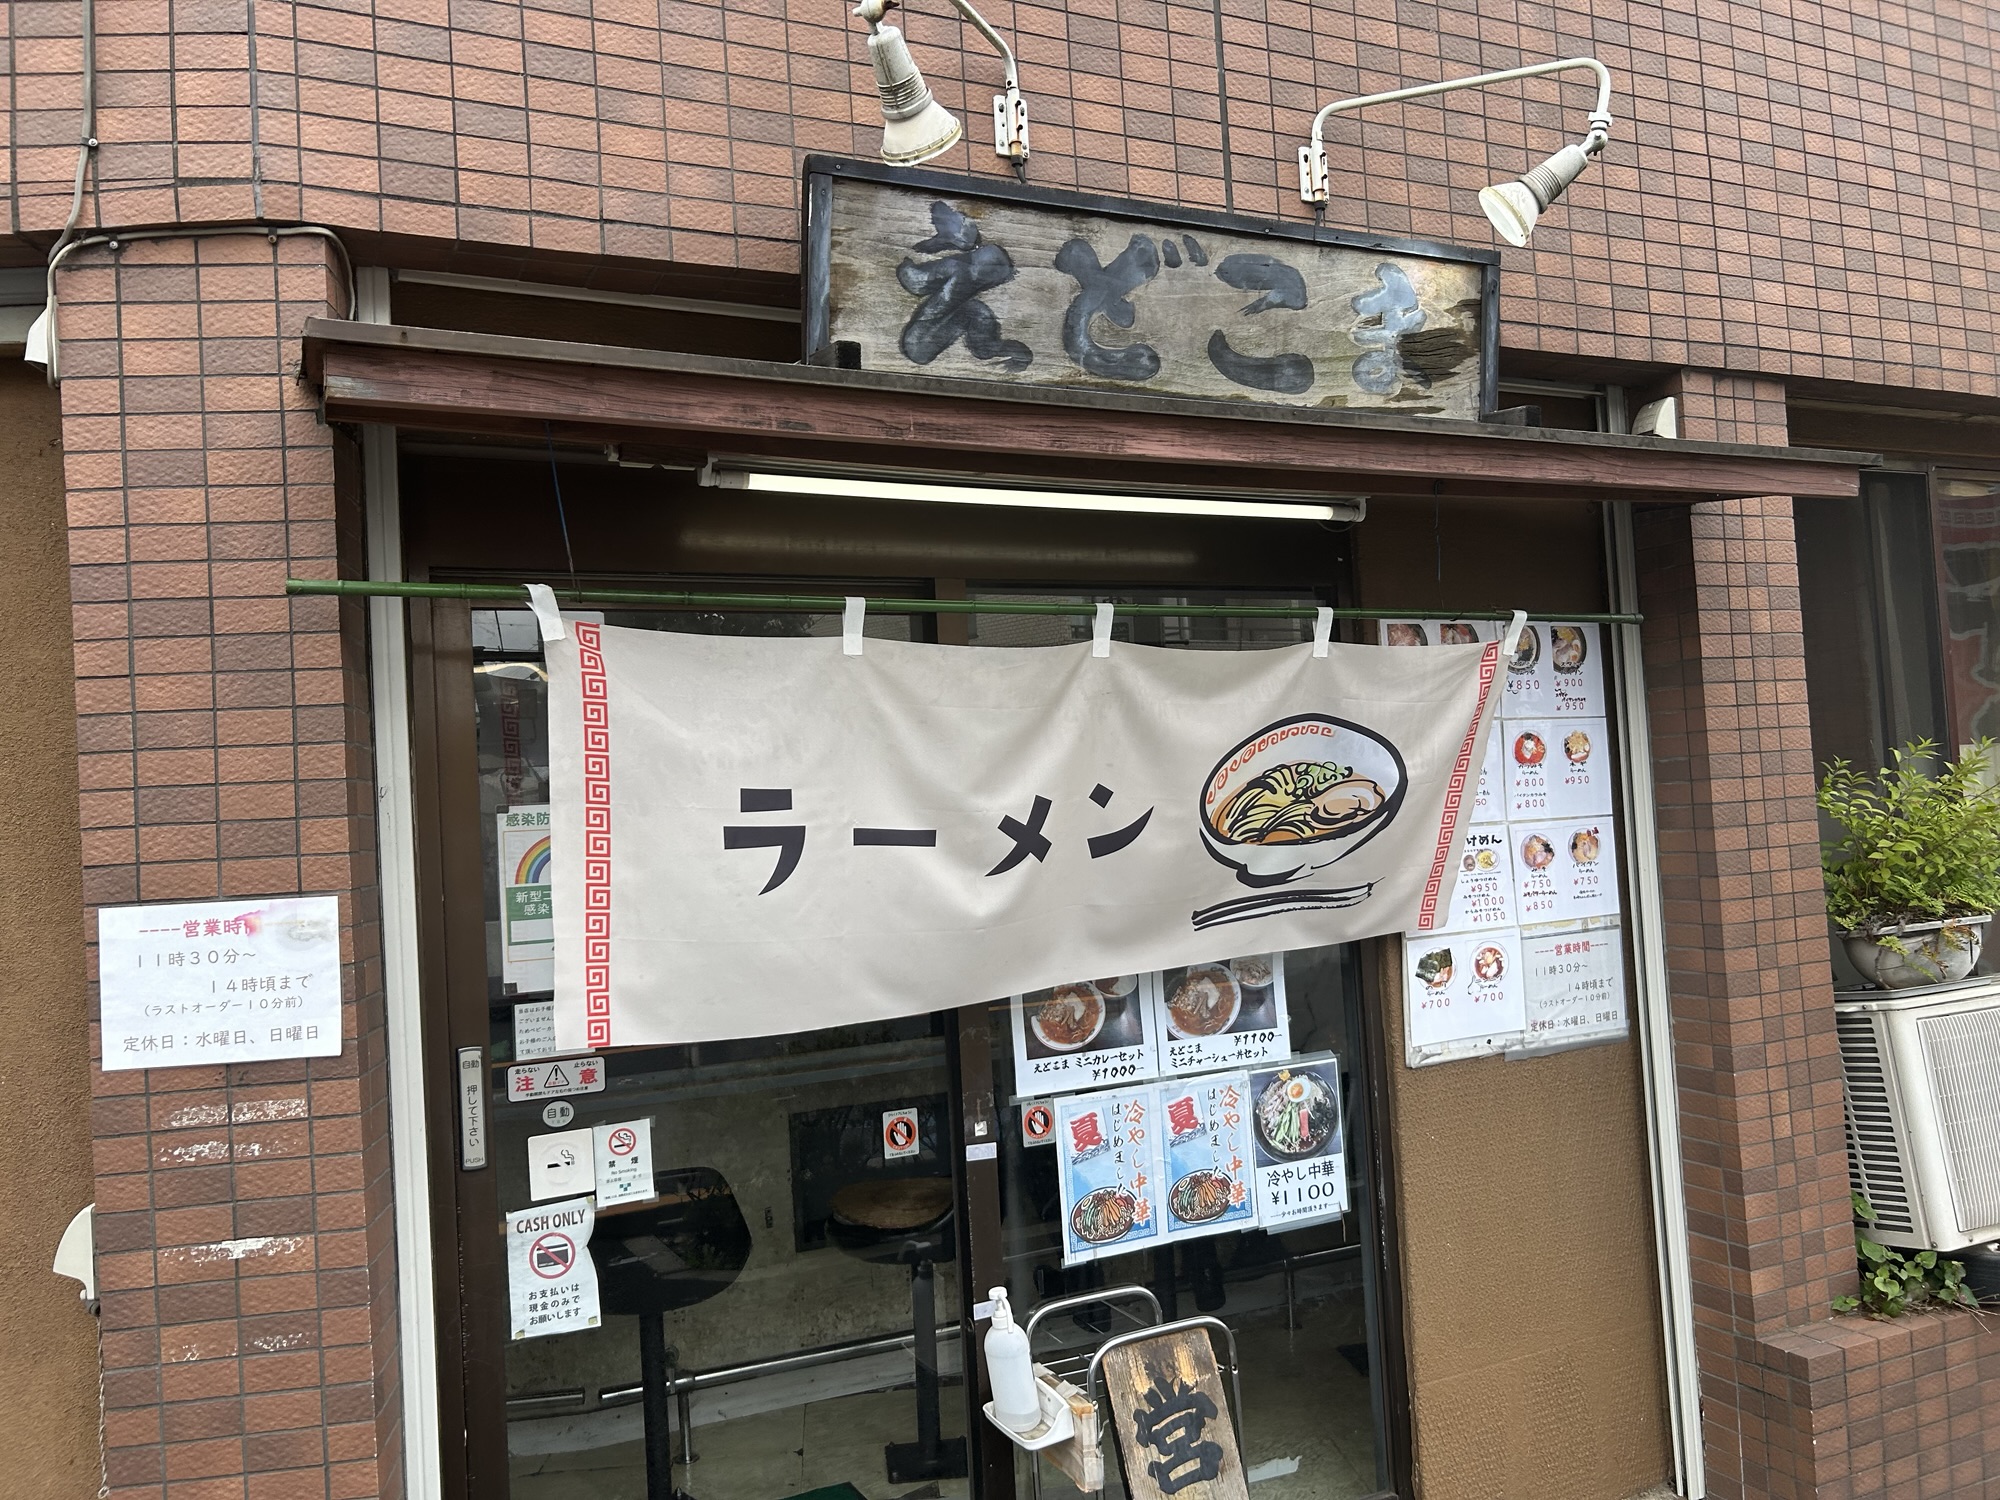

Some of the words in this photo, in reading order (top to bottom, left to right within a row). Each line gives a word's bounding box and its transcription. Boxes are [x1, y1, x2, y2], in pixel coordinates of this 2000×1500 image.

[1507, 680, 1540, 690] ¥850
[1556, 678, 1583, 687] ¥900
[1556, 702, 1584, 711] ¥950
[1515, 778, 1545, 787] ¥800
[1564, 775, 1590, 784] ¥950
[1516, 799, 1545, 809] ¥800
[723, 782, 1155, 896] ラーメン
[1471, 882, 1498, 893] ¥950
[1524, 879, 1551, 889] ¥750
[1574, 875, 1599, 885] ¥750
[1471, 896, 1505, 907] ¥1000
[1526, 900, 1553, 912] ¥850
[1473, 911, 1506, 923] ¥1050
[211, 973, 313, 993] 14時頃まで
[1421, 998, 1451, 1009] ¥700
[1474, 991, 1504, 1003] ¥700
[1169, 1042, 1203, 1057] えどこま
[462, 1060, 480, 1069] 自動
[1033, 1059, 1070, 1074] えどこま
[1075, 1048, 1145, 1068] ミニカレーセット
[466, 1084, 480, 1147] 押して下さい
[547, 1105, 570, 1119] 自動
[1167, 1095, 1199, 1135] 夏
[1069, 1111, 1103, 1152] 夏
[1207, 1087, 1223, 1178] はじめました
[1111, 1102, 1128, 1196] はじめました
[1219, 1084, 1247, 1207] 冷やし中華
[465, 1156, 484, 1165] PUSH
[1123, 1099, 1151, 1225] 冷やし中華
[1266, 1159, 1335, 1188] 冷やし中華
[1271, 1181, 1334, 1205] ¥1100
[516, 1215, 549, 1234] CASH
[552, 1209, 585, 1228] ONLY
[528, 1283, 580, 1301] お支払いは
[529, 1295, 581, 1313] 現金のみで
[529, 1307, 581, 1326] お願いします
[1132, 1376, 1224, 1496] 営
